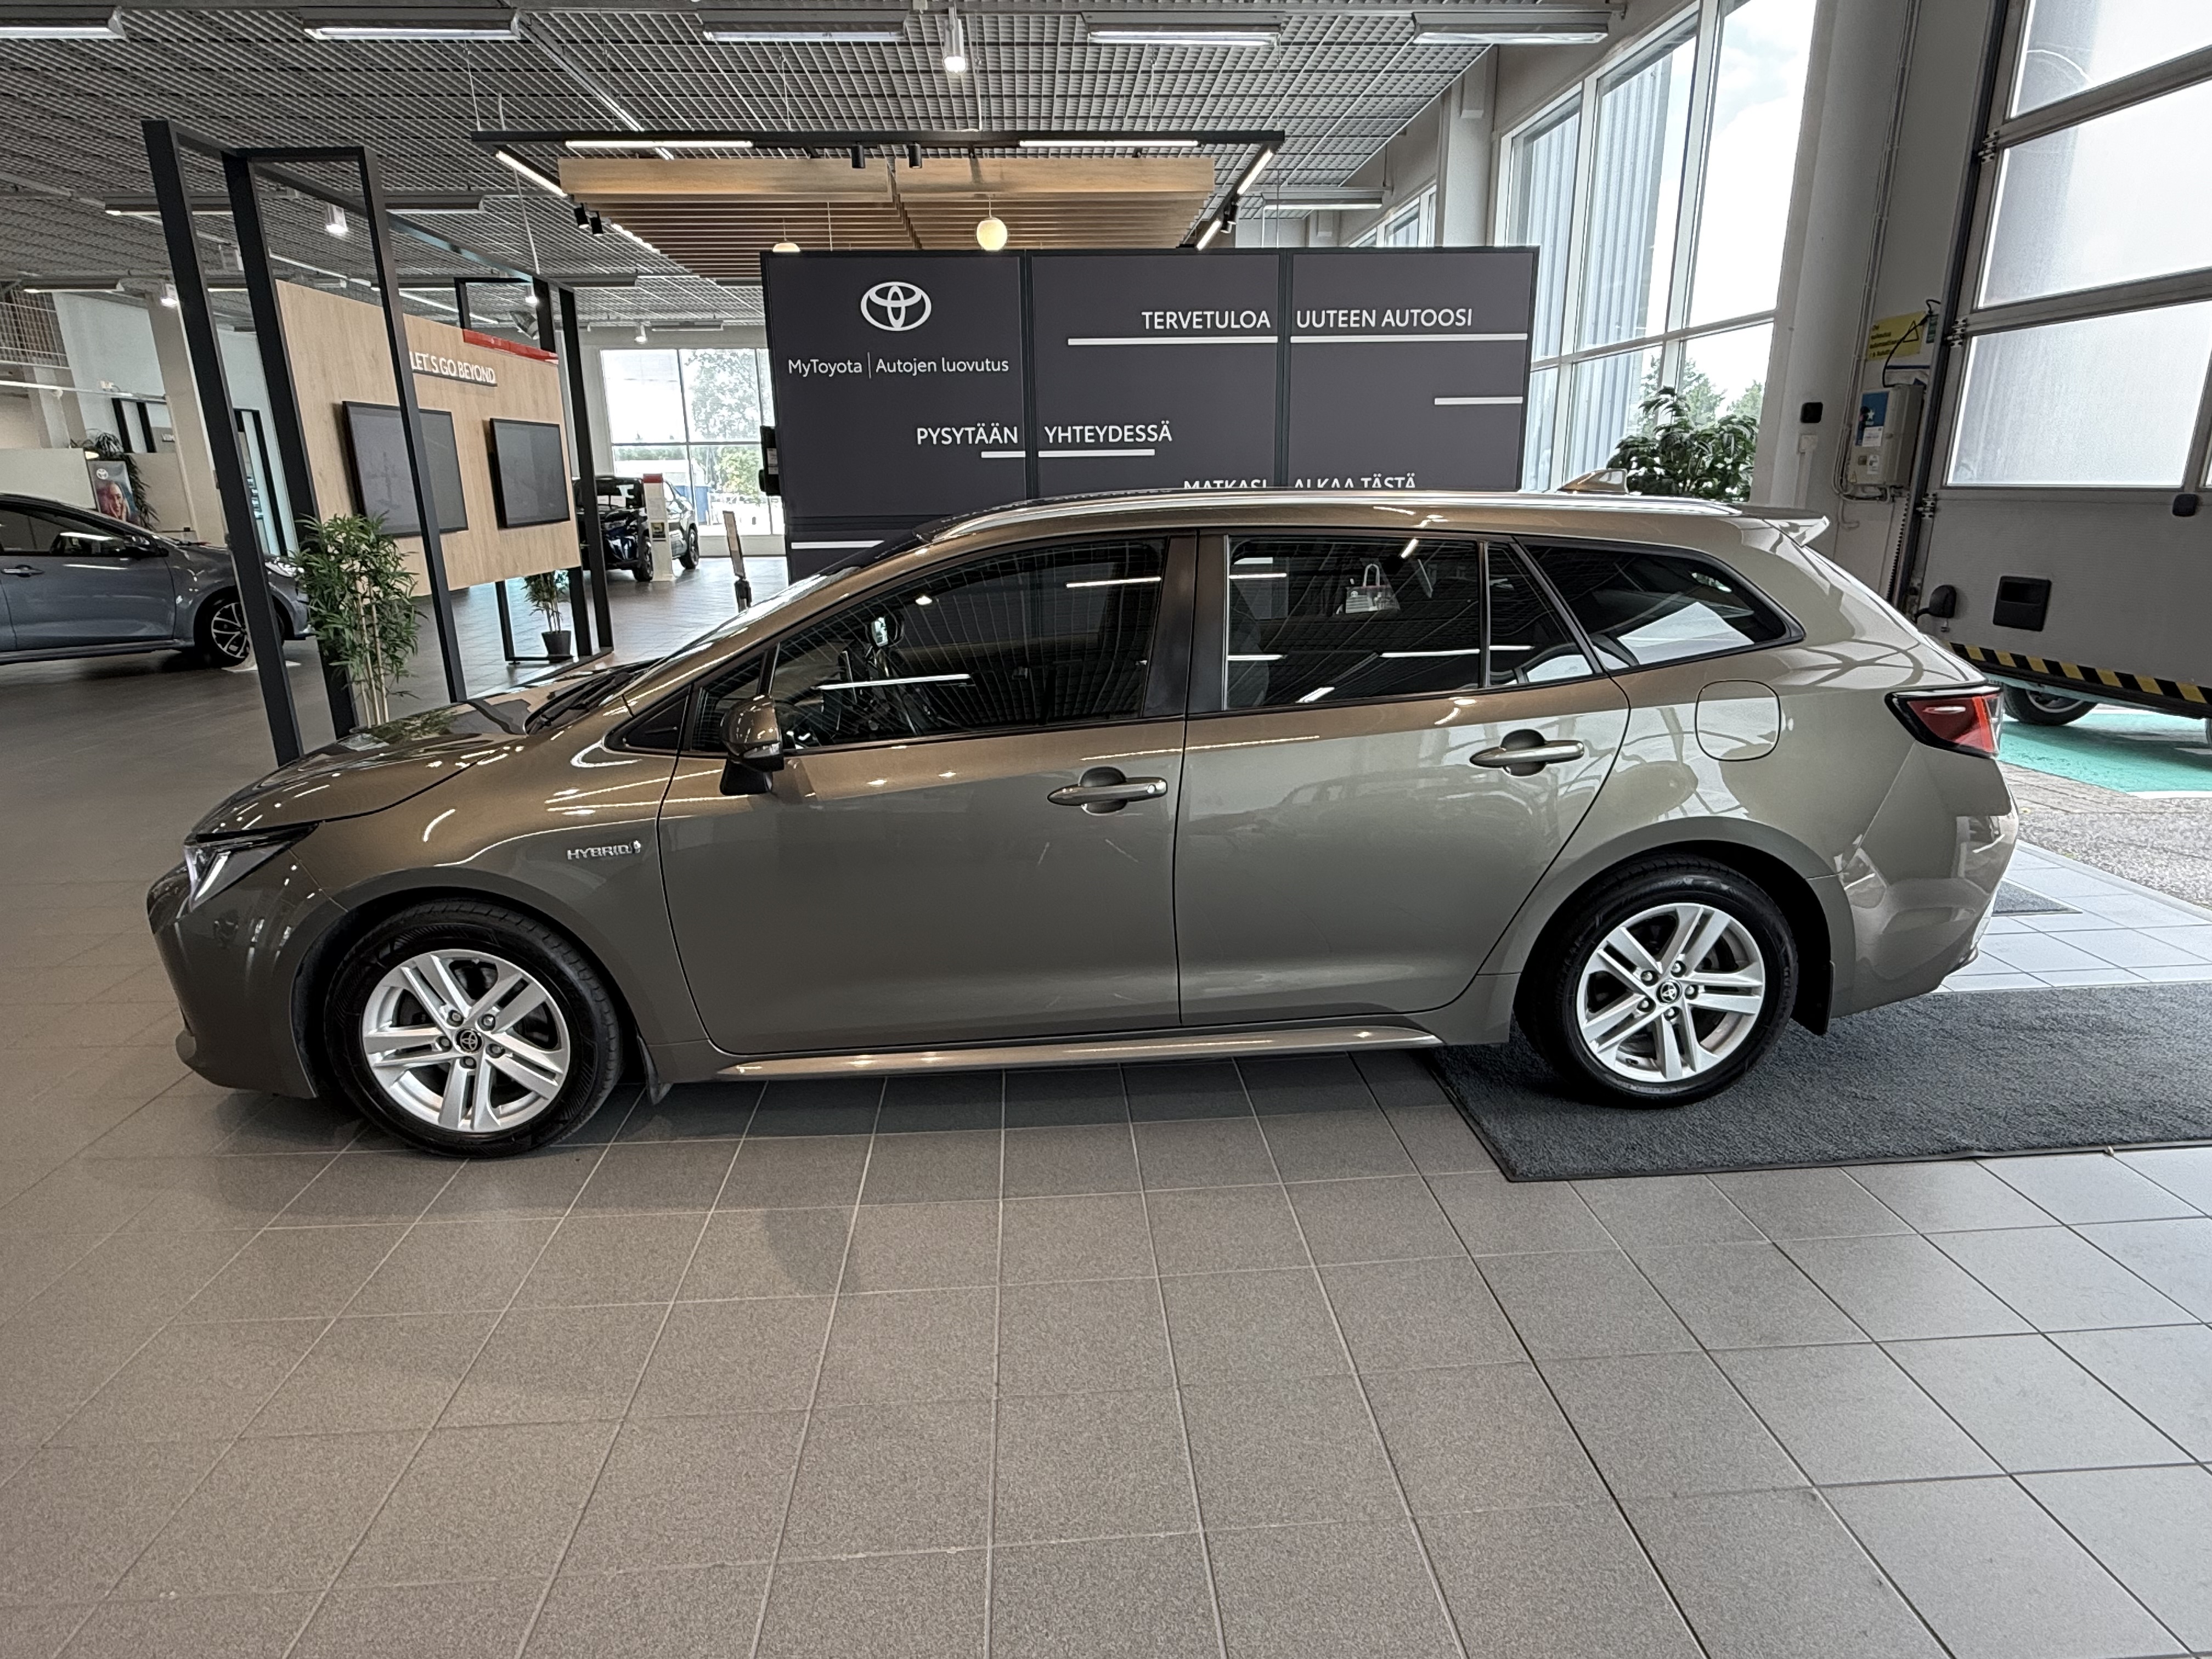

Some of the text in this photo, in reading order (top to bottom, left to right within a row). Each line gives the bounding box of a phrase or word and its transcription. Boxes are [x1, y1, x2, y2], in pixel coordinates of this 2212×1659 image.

[1141, 308, 1472, 329] TERVETULOA UUTEEN AUTOOSI
[409, 351, 496, 383] LET'S GO BEYOND
[788, 357, 1009, 377] MyToyota Autojen luovutus
[917, 420, 1173, 445] PYSYTÄÄN YHTEYDESSÄ
[1361, 472, 1415, 488] TÄSTÄ
[567, 844, 631, 860] HYBRID
